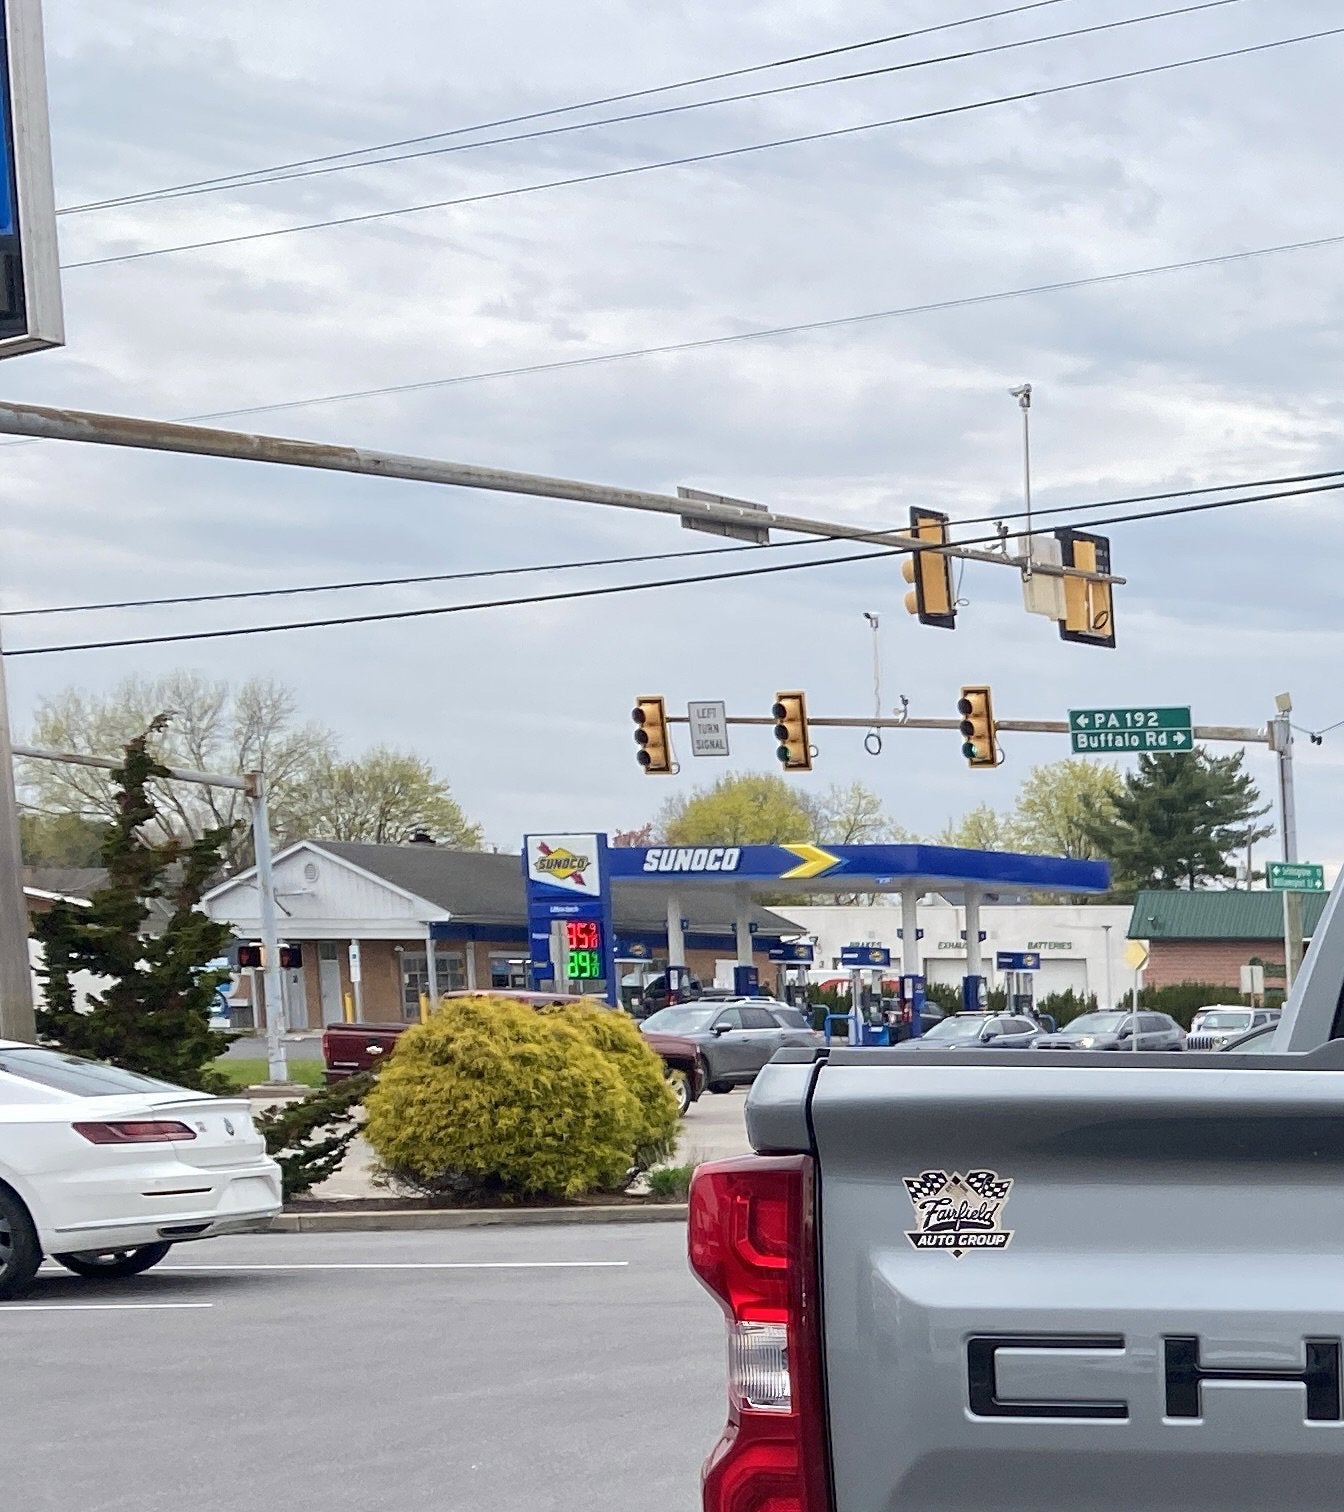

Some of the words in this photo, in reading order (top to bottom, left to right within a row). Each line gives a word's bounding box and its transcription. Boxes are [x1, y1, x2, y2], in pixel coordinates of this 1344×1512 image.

[697, 707, 717, 719] LEFT
[1094, 712, 1120, 728] PA
[1125, 711, 1159, 727] 192
[697, 723, 719, 734] TURN
[696, 739, 725, 750] SIGNAL
[1077, 732, 1140, 748] Buffalo
[1145, 731, 1167, 746] Rd
[538, 857, 585, 870] SUNOCO
[643, 848, 741, 872] SUNOCO
[1027, 941, 1072, 950] BATTERIES
[919, 1197, 1000, 1231] Fairfield
[917, 1234, 955, 1246] AUTO
[958, 1234, 1006, 1246] GROUP
